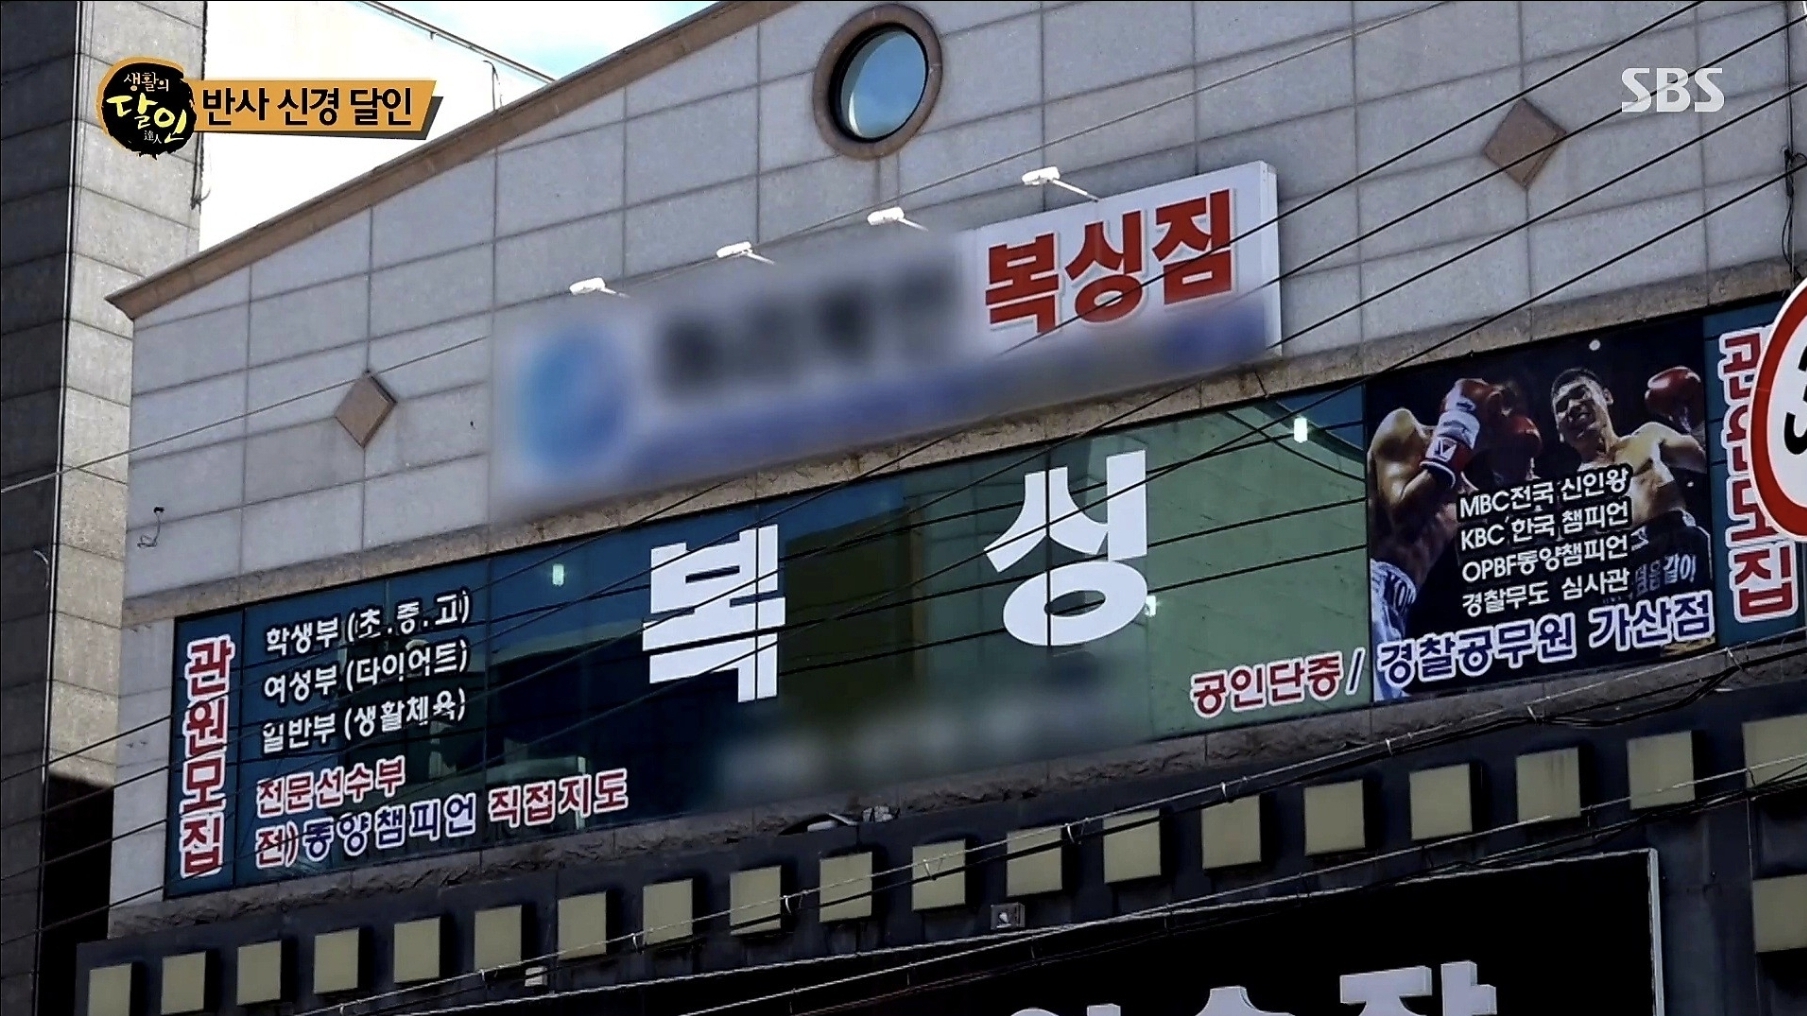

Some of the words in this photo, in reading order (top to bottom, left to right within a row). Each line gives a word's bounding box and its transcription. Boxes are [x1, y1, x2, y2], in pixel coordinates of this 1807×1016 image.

[985, 188, 1237, 335] 복싱짐
[1560, 467, 1630, 501] 신인왕
[1461, 523, 1505, 551] KBC
[1510, 514, 1555, 543] 한국
[1561, 500, 1629, 534] 챔피언
[1462, 580, 1550, 618] 경찰무도
[1561, 567, 1631, 601] 심사관
[265, 616, 339, 656] 학생부
[1377, 612, 1577, 689] 경찰공무원
[1588, 589, 1715, 651] 가산점
[263, 664, 338, 704] 여성부
[262, 713, 337, 754] 일반부
[344, 687, 466, 742] (생활체육)
[180, 634, 235, 878] 관원모집
[256, 755, 406, 819] 전문선수부
[488, 767, 629, 828] 직접지도
